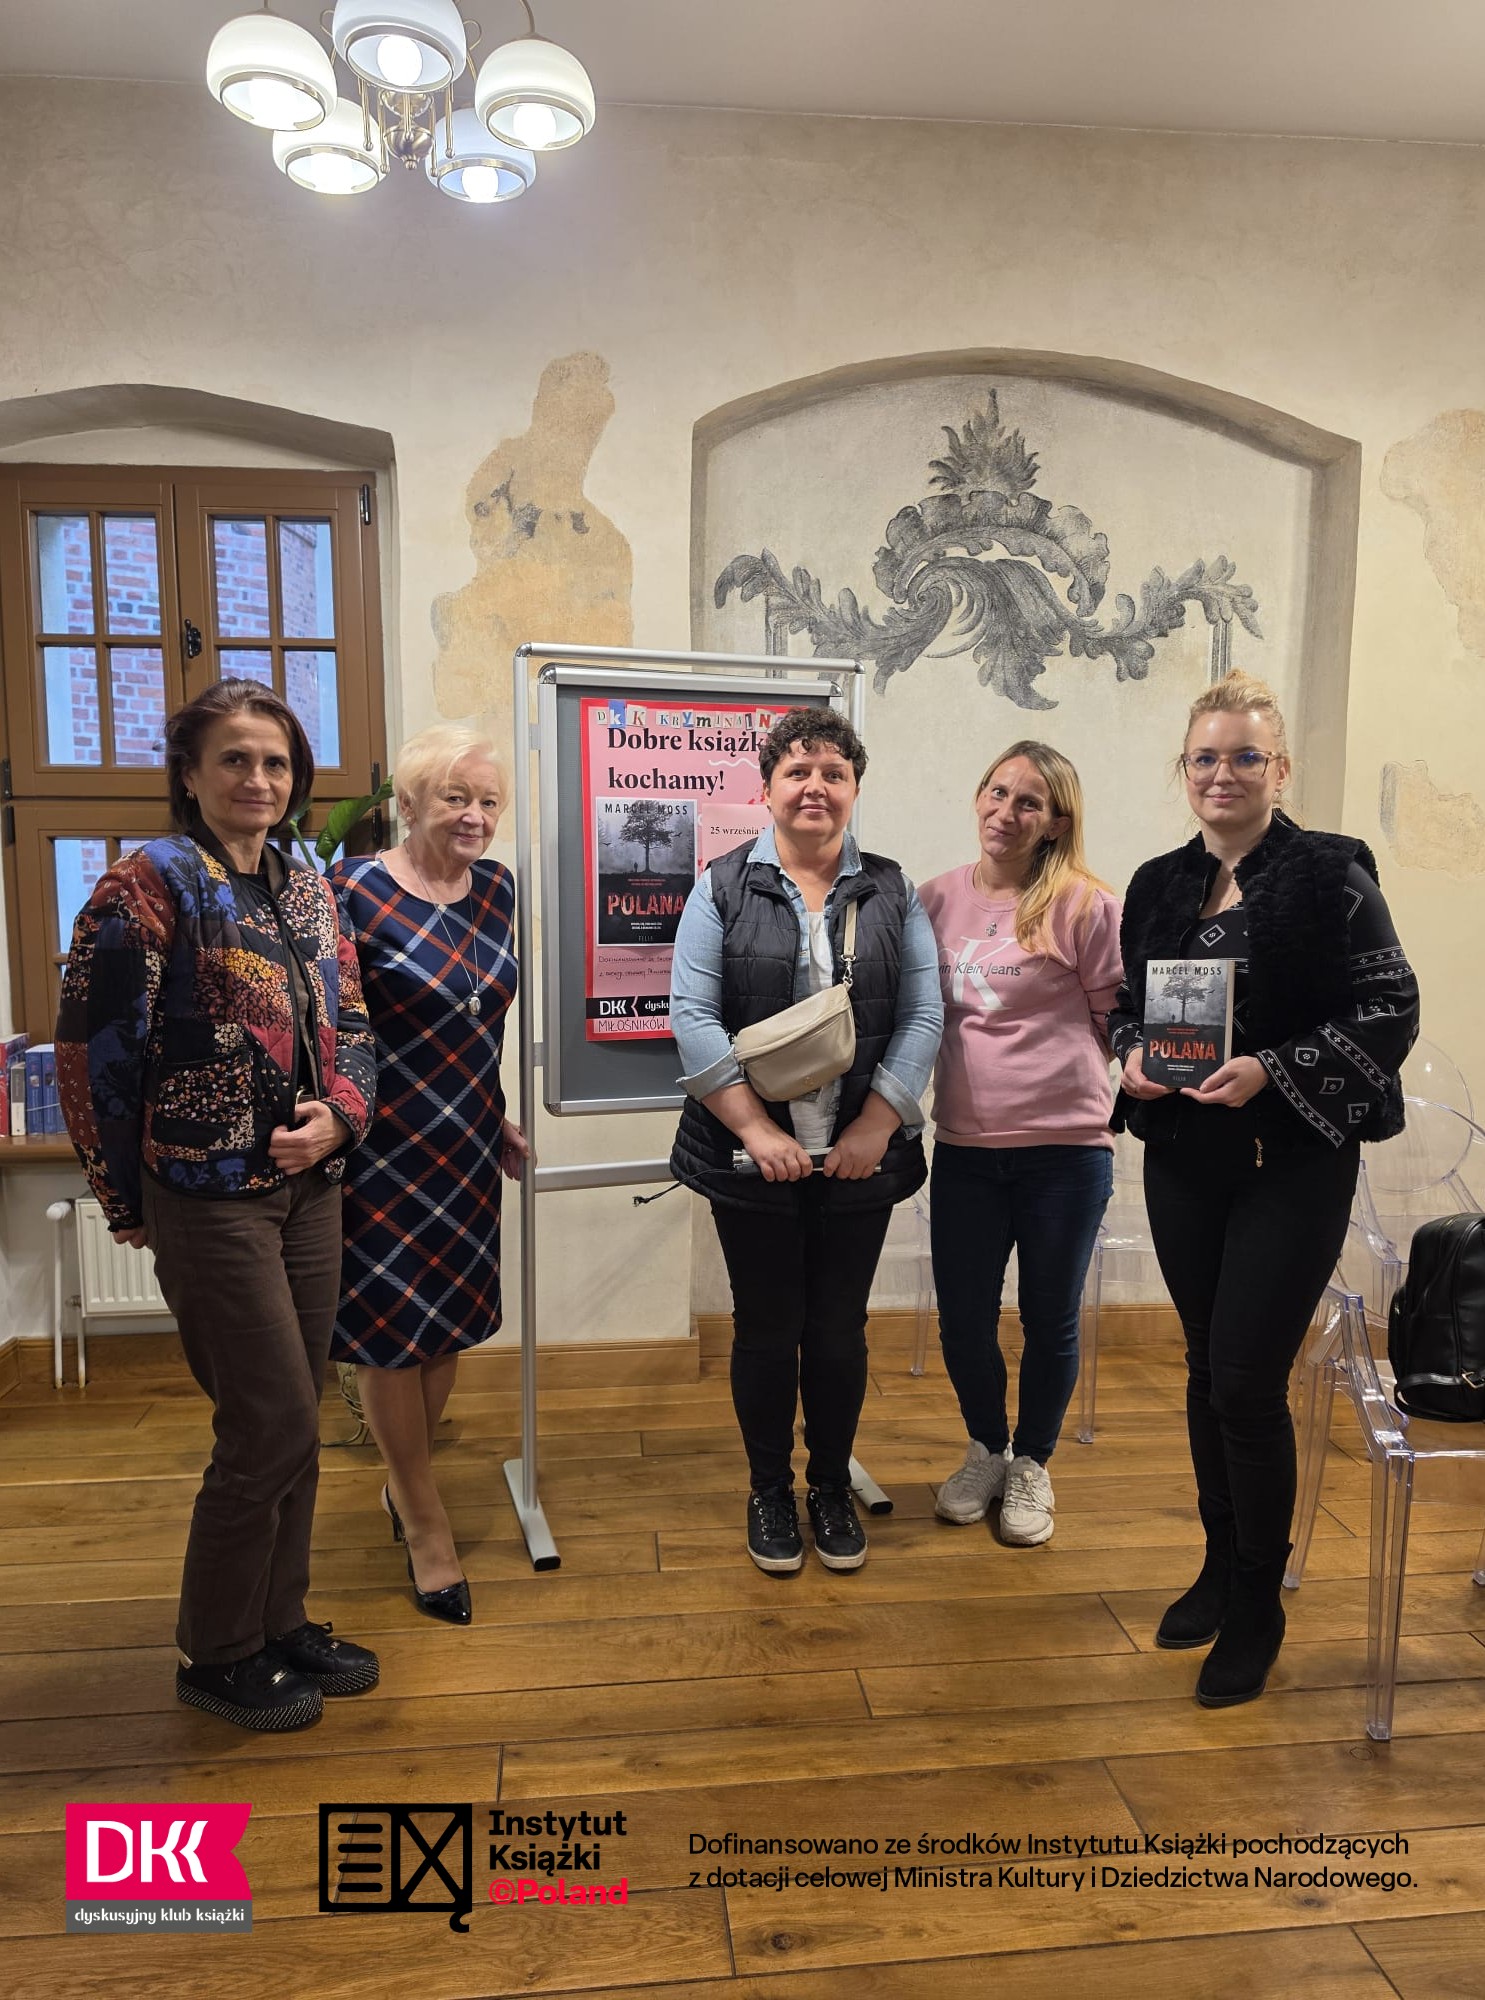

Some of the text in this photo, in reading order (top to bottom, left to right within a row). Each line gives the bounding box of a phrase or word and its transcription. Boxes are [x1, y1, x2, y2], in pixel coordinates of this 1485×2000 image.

[607, 727, 682, 750] Dobre
[608, 767, 725, 796] kochamy!
[605, 803, 688, 815] MARCEL MOSS
[710, 826, 720, 835] 25
[722, 826, 759, 836] września
[607, 894, 685, 916] POLANA
[955, 962, 984, 975] Klein
[984, 962, 1021, 978] Jeans
[1152, 966, 1222, 976] MARCEL MOSS
[599, 999, 627, 1016] DKK
[598, 1016, 665, 1032] MIŁOŚNIKÓW
[1149, 1040, 1217, 1061] POLANA
